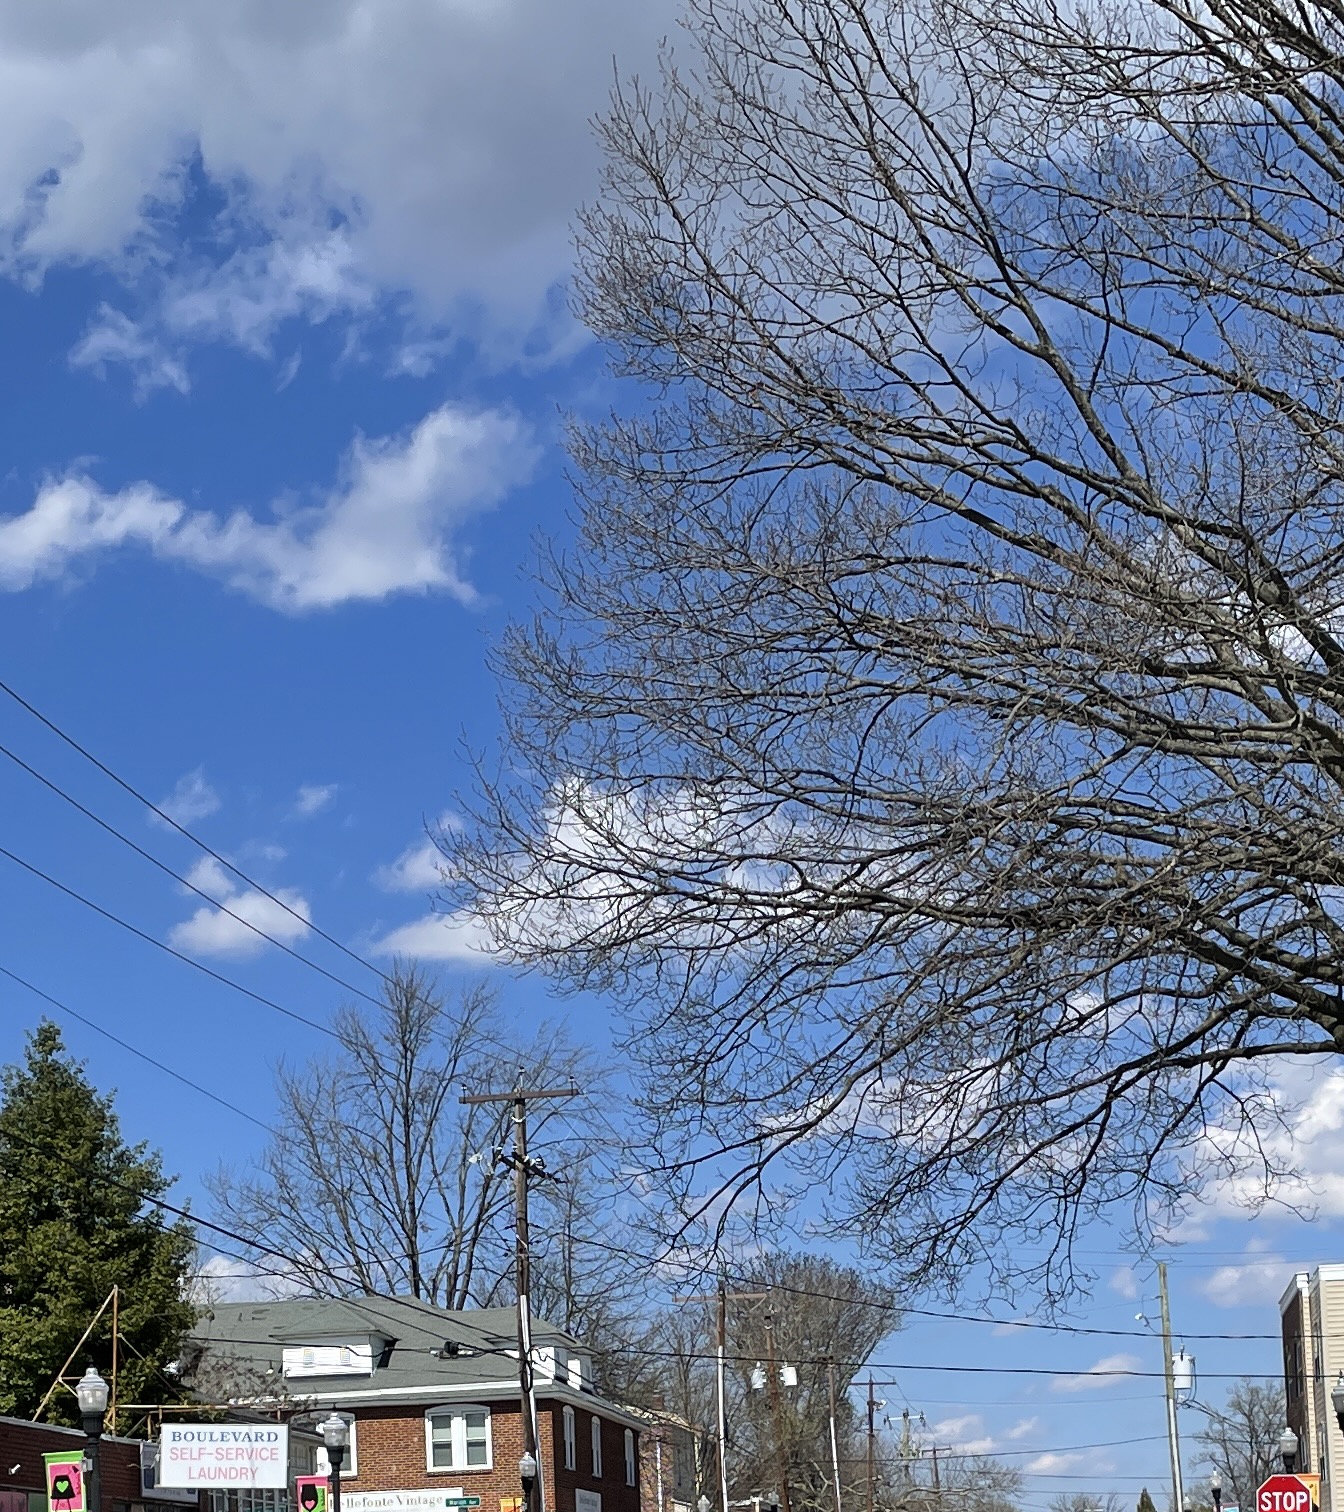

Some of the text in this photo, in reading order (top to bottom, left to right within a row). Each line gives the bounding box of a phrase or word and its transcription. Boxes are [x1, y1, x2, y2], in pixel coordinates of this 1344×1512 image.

[171, 1430, 279, 1443] BOULEVARD
[169, 1446, 280, 1462] SELF-SERVICE
[187, 1466, 259, 1481] LAUNDRY
[330, 1496, 394, 1510] llefonte
[395, 1494, 444, 1511] Vintage
[1260, 1491, 1308, 1512] STOP
